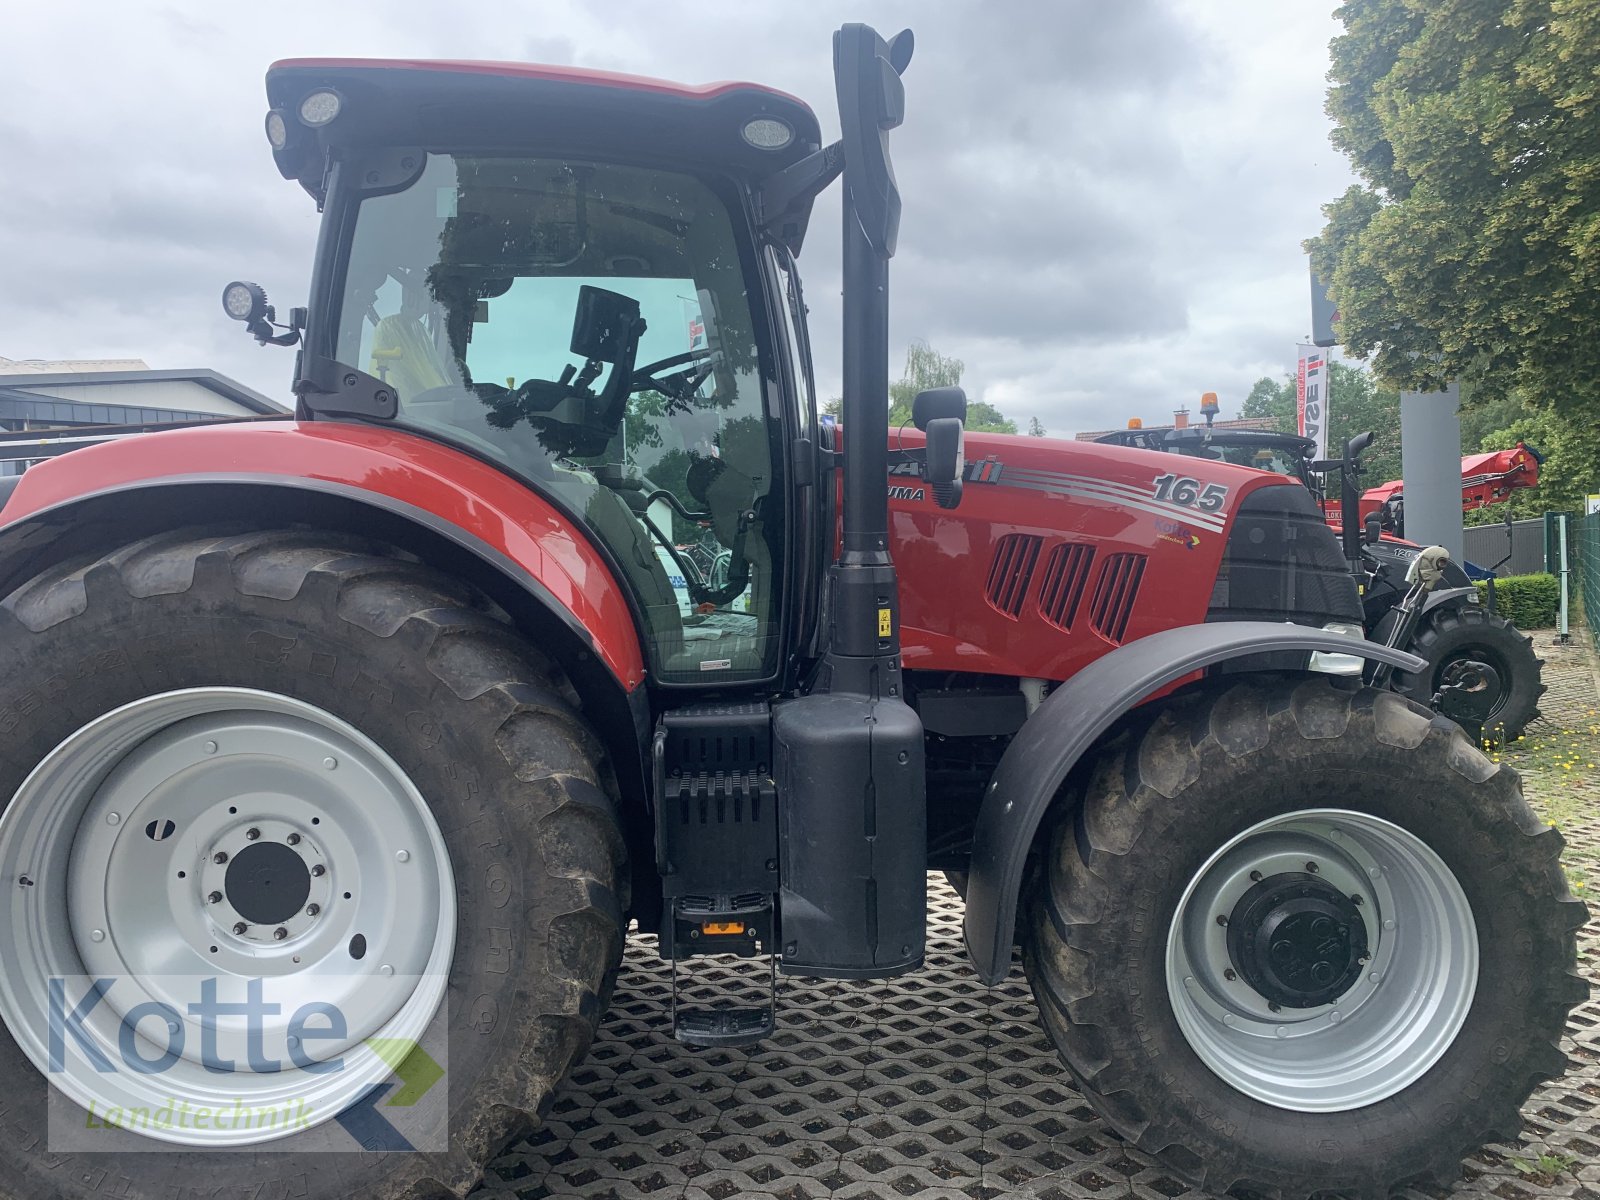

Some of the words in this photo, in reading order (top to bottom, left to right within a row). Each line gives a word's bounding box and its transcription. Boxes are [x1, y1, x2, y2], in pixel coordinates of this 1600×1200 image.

[888, 485, 925, 500] UMA
[1152, 473, 1229, 514] 165
[1154, 519, 1191, 539] Kotte
